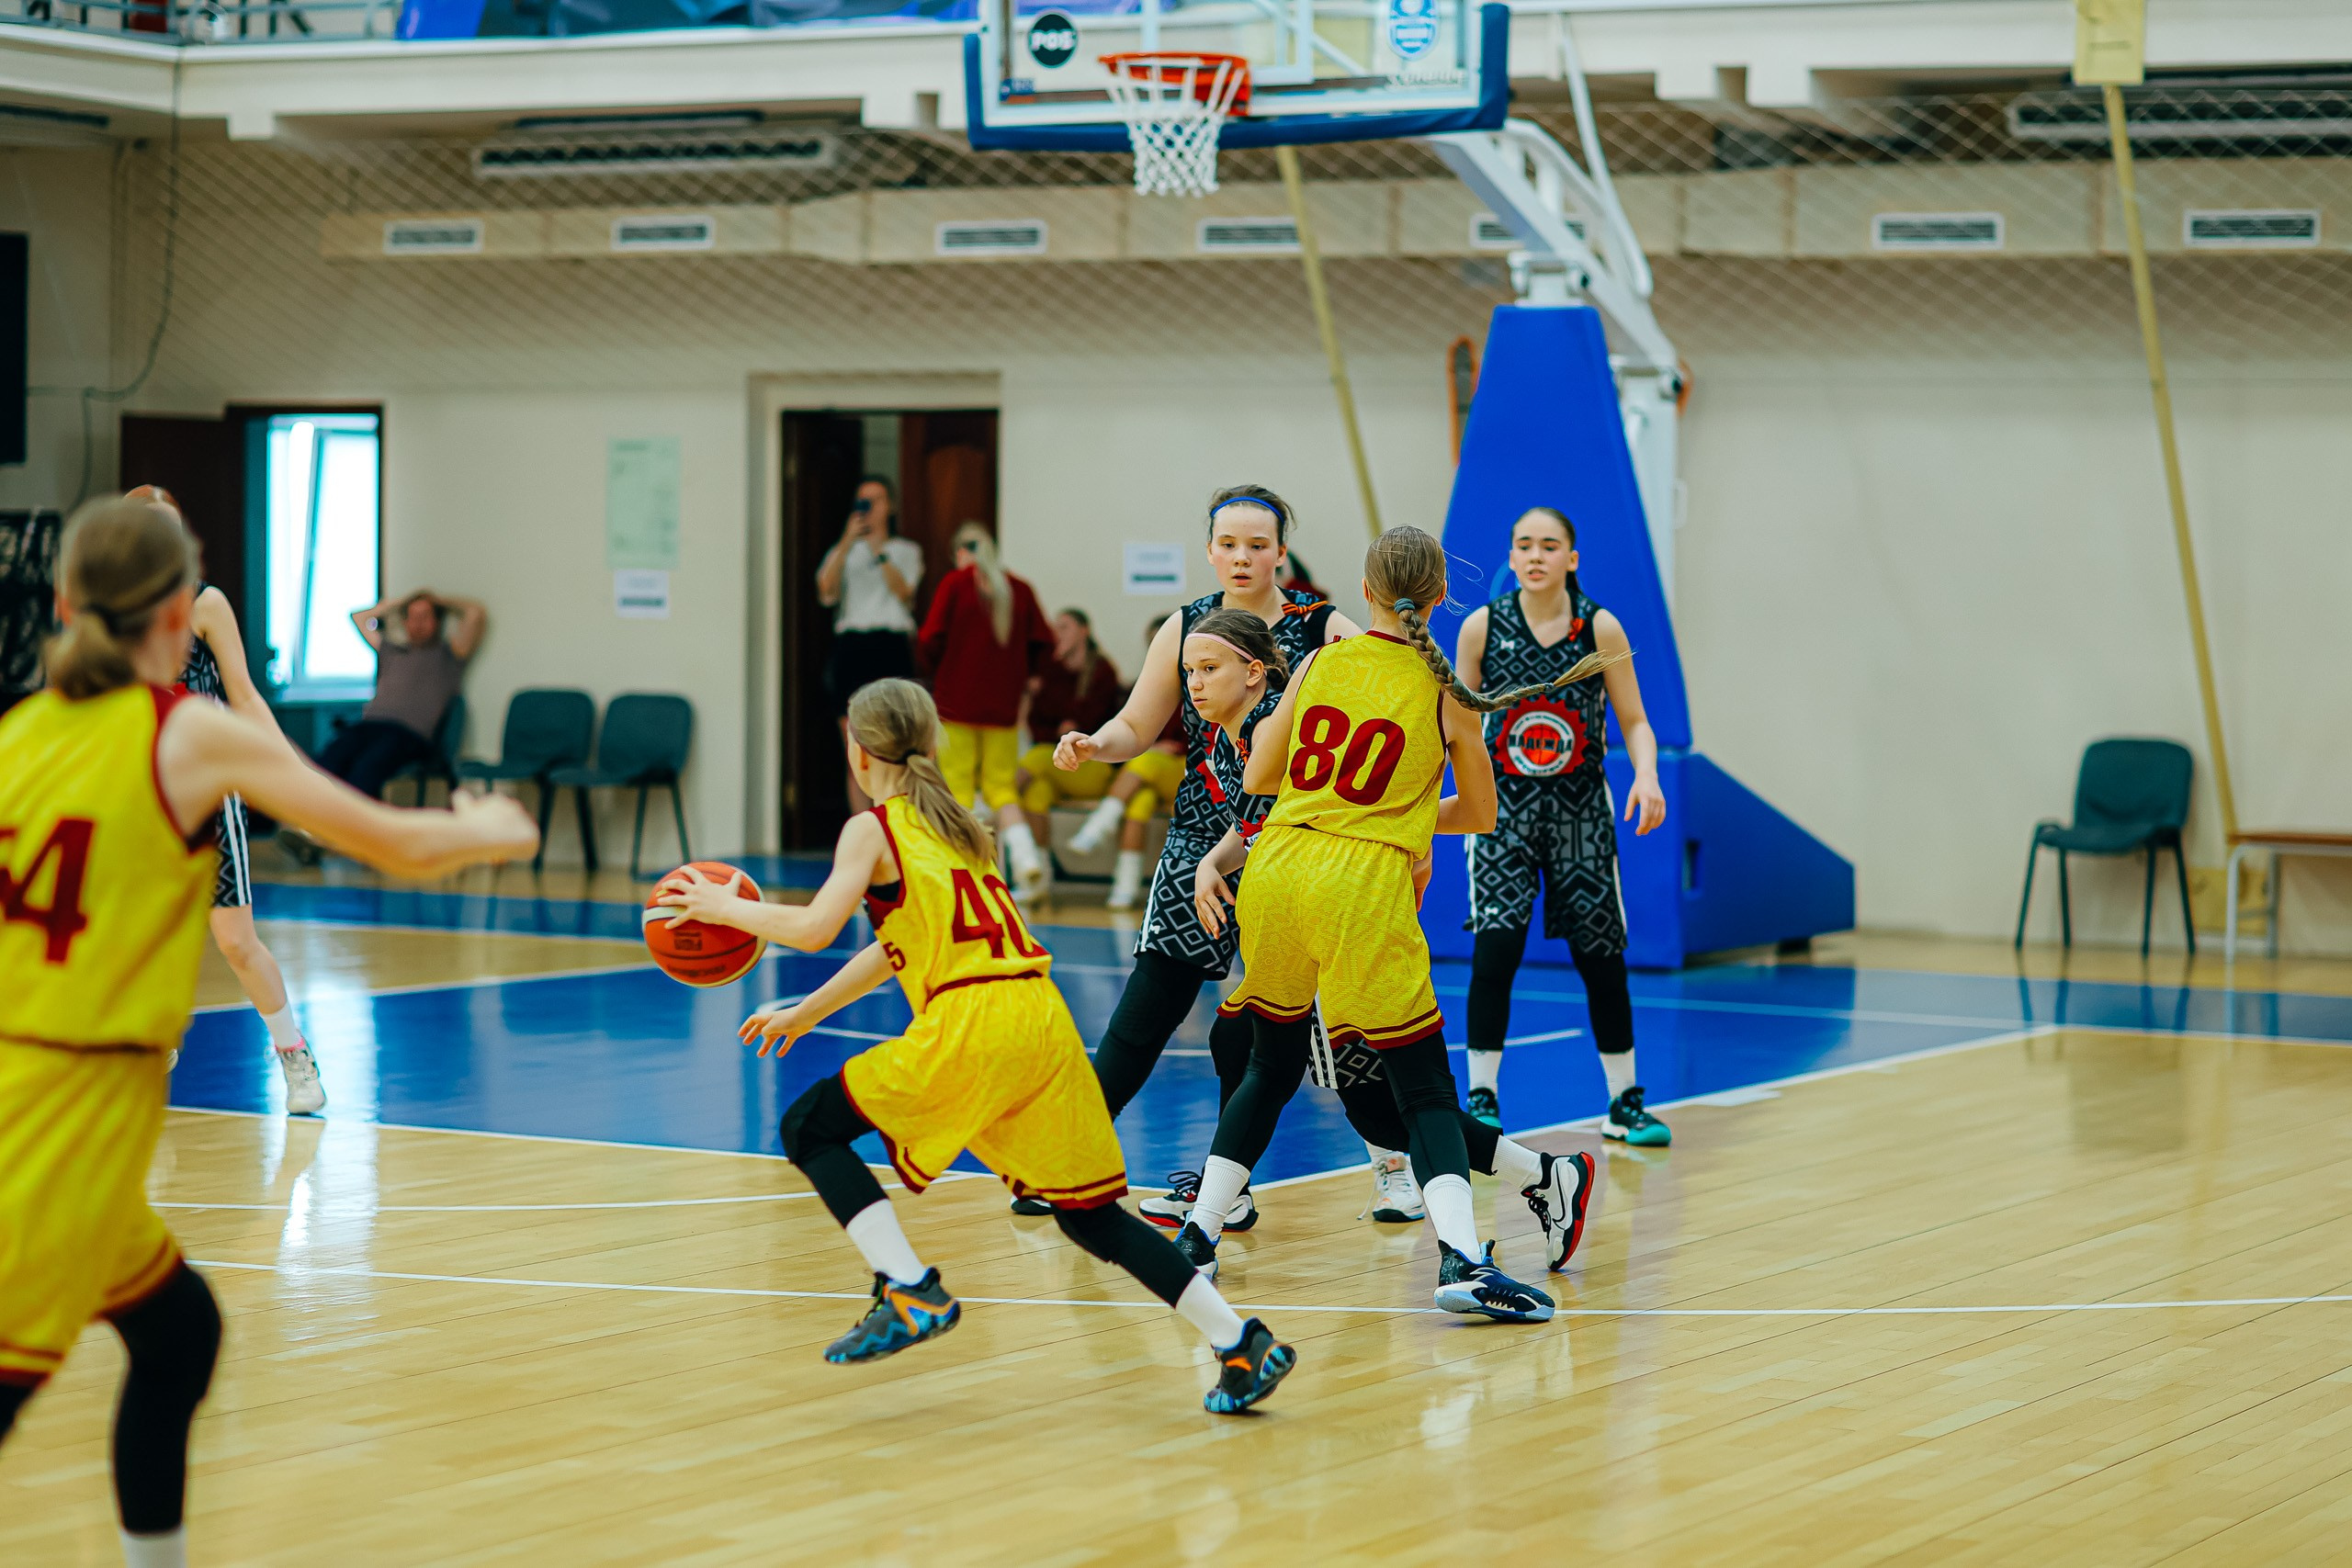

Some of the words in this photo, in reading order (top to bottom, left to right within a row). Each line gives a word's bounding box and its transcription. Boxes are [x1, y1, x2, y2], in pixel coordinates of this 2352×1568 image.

[1289, 705, 1406, 806] 80
[0, 817, 96, 964] 4
[951, 869, 1051, 958] 40
